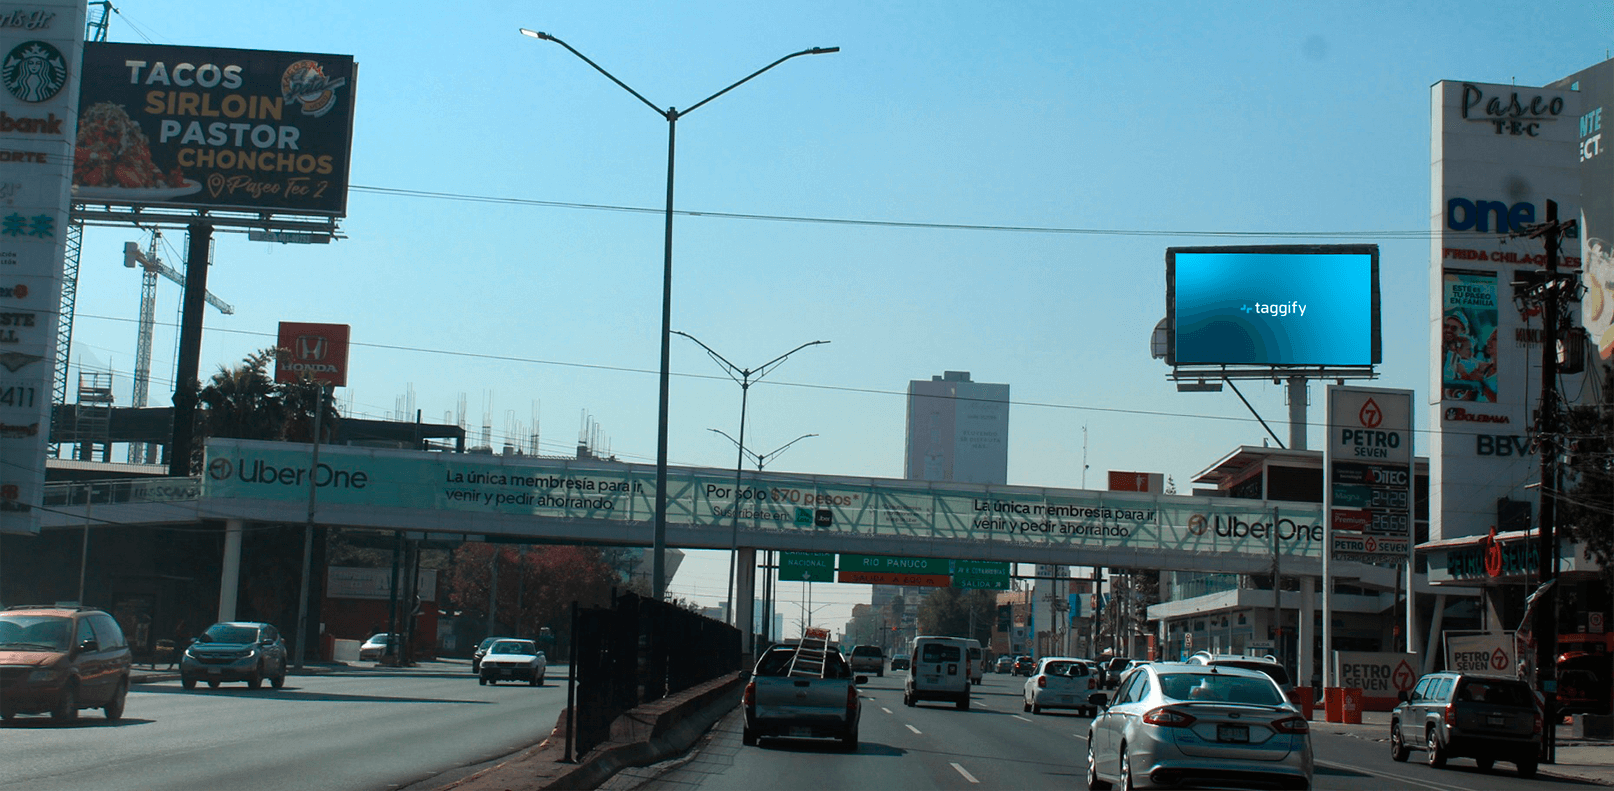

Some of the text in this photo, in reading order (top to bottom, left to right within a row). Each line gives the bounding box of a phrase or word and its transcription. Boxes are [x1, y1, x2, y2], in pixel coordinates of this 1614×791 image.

[125, 60, 243, 89] TACOS
[144, 90, 283, 120] SIRLOIN
[1462, 82, 1564, 119] Paseo
[159, 119, 300, 150] PASTOR
[1579, 134, 1604, 163] CT.
[177, 148, 334, 174] CHONCHOS
[227, 175, 328, 198] Paseo Tec 2
[1447, 197, 1536, 234] one
[1442, 247, 1488, 261] FRIDA
[1452, 285, 1472, 293] ESTE
[1465, 292, 1491, 300] PASEO
[1255, 301, 1307, 316] taggify
[1463, 298, 1494, 306] FAMILIA
[281, 363, 338, 373] HONDA
[0, 386, 35, 407] 411
[1342, 429, 1400, 448] PETRO
[1476, 435, 1536, 457] BBV
[1354, 447, 1388, 458] SEVEN
[238, 458, 368, 489] Uber One
[446, 470, 644, 494] La única membresía para ir,
[445, 489, 615, 510] venir y pedir ahorrando.
[706, 484, 732, 499] Por
[736, 486, 767, 500] sólo
[770, 488, 801, 503] $70
[713, 506, 789, 521] Suscríbete en:
[974, 499, 1157, 523] La única membresía para ir,
[1334, 516, 1366, 525] Premium
[974, 517, 1132, 537] venir y pedir ahorrando.
[1214, 515, 1323, 541] Uber One
[1335, 541, 1364, 550] PETRO
[1379, 543, 1407, 552] SEVEN
[788, 559, 826, 567] NACIONAL
[863, 558, 928, 568] RIO PANUCO
[1447, 548, 1483, 575] PETRO
[1502, 544, 1540, 571] SEVEN
[853, 574, 885, 582] SALIDA
[961, 580, 991, 588] SALIDA
[1454, 652, 1490, 663] PETRO
[1456, 661, 1488, 671] SEVEN
[1342, 663, 1391, 680] PETRO
[1345, 678, 1388, 691] SEVEN
